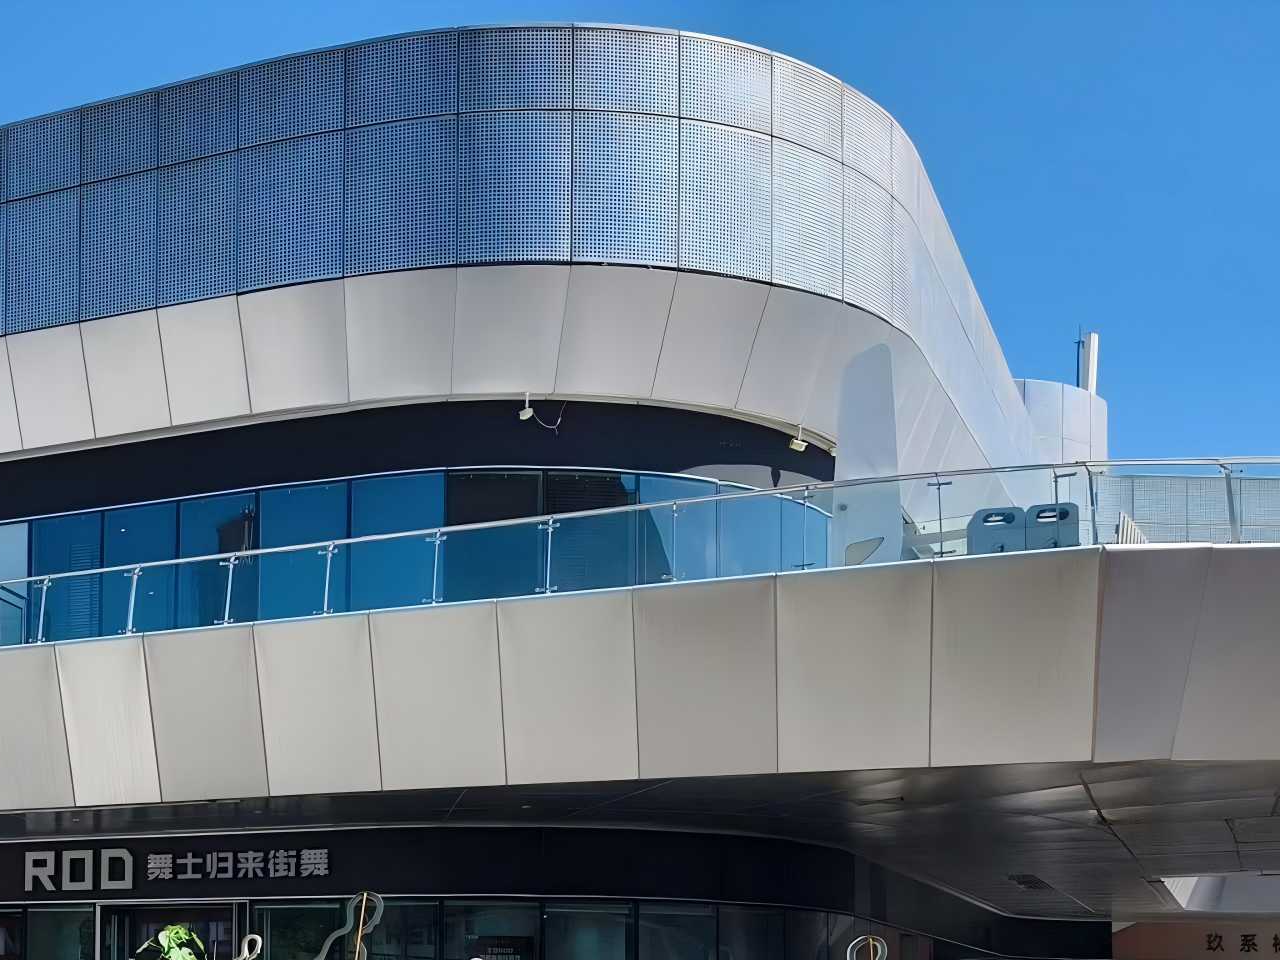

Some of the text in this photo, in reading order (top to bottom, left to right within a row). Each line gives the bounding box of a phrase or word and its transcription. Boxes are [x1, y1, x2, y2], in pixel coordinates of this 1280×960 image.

[24, 848, 329, 891] ROD 舞士归来街舞
